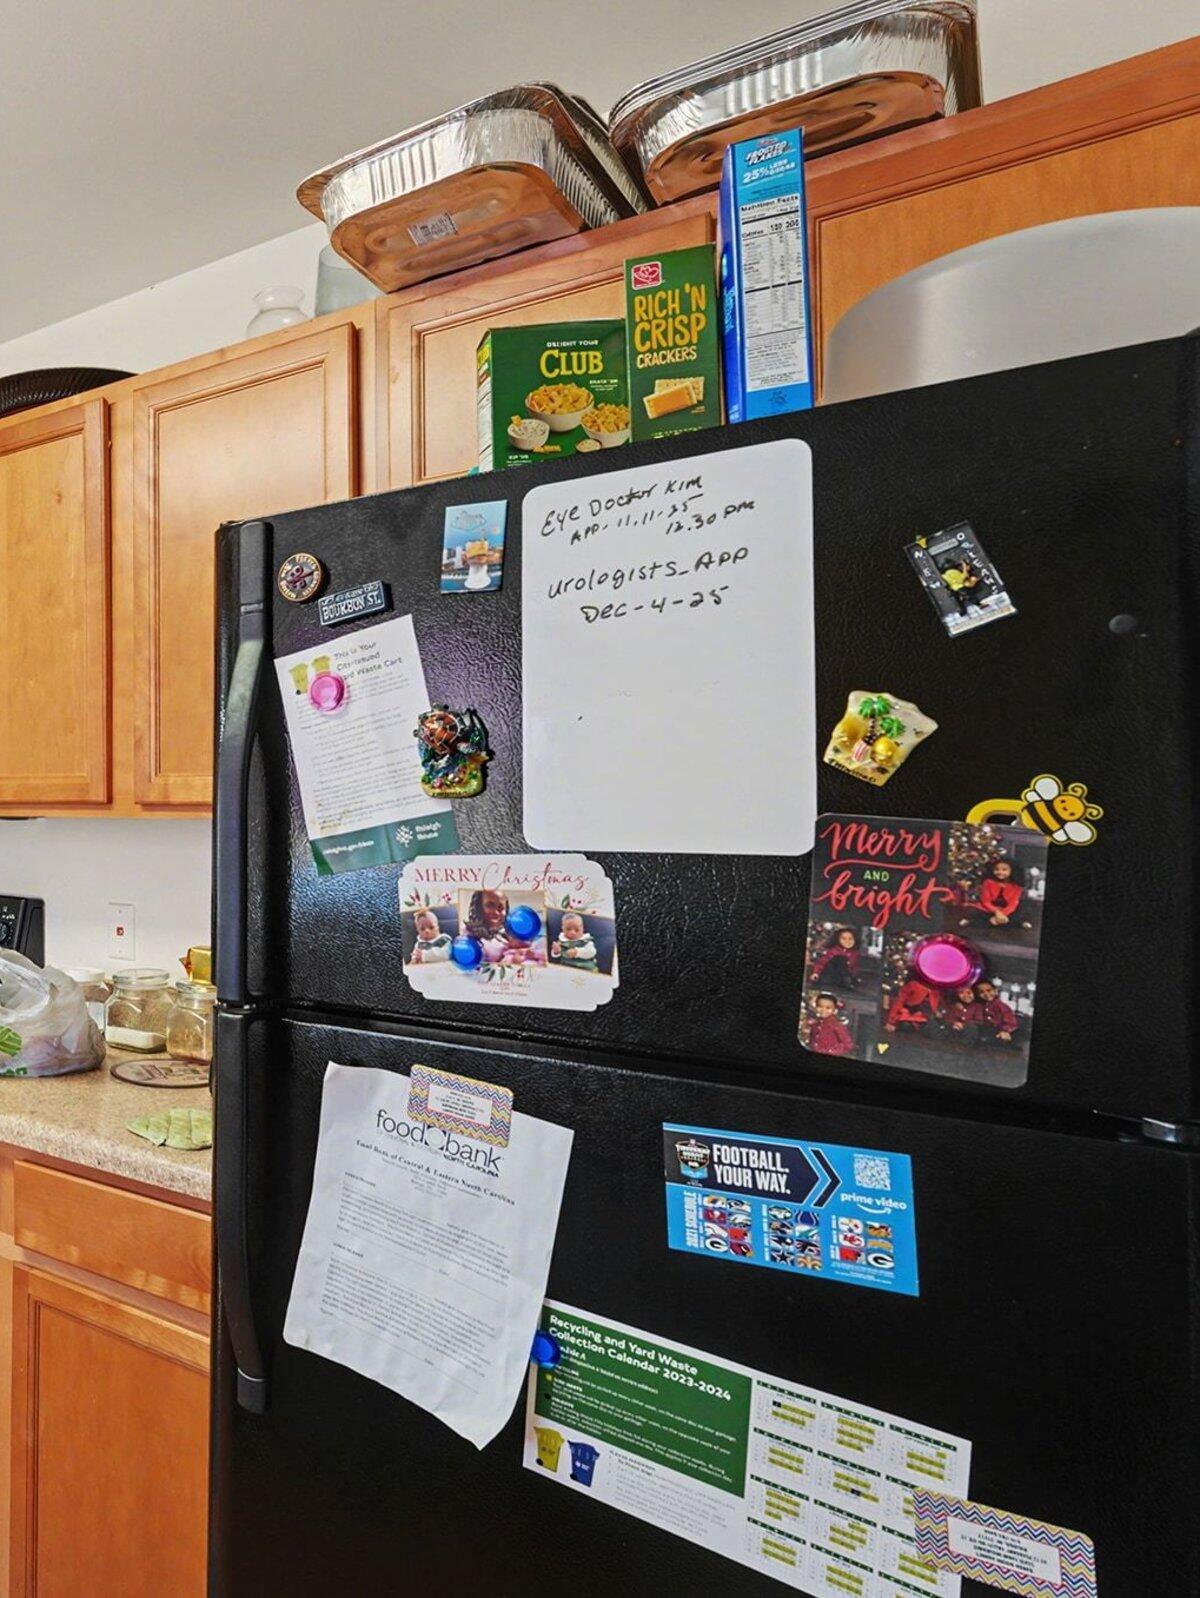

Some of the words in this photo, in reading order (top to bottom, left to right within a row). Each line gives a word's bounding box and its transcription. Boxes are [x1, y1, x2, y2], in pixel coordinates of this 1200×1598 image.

[634, 289, 680, 322] RICH
[684, 283, 706, 311] 'N
[634, 313, 706, 353] CRISP
[540, 349, 604, 378] CLUB
[636, 346, 697, 369] CRACKERS
[541, 505, 580, 537] Eye
[589, 484, 657, 517] Doctor
[322, 594, 367, 620] BOURBON
[360, 642, 377, 651] Your
[384, 657, 402, 668] Cart
[819, 822, 942, 873] Merry
[415, 867, 482, 883] MERRY
[482, 862, 589, 892] Christmas
[863, 870, 890, 882] AND
[812, 870, 956, 930] bright
[376, 1109, 426, 1143] food
[445, 1133, 503, 1172] bank
[712, 1143, 790, 1173] FOOTBALL.
[714, 1164, 752, 1188] YOUR
[754, 1170, 791, 1194] WAY.
[841, 1193, 873, 1205] prime
[875, 1197, 907, 1210] video
[550, 1314, 602, 1343] Recycling
[603, 1335, 625, 1349] and
[628, 1341, 655, 1360] Yard
[658, 1353, 698, 1376] Waste
[549, 1326, 606, 1355] Collection
[607, 1346, 661, 1375] Calendar
[662, 1367, 732, 1402] 2023-2024
